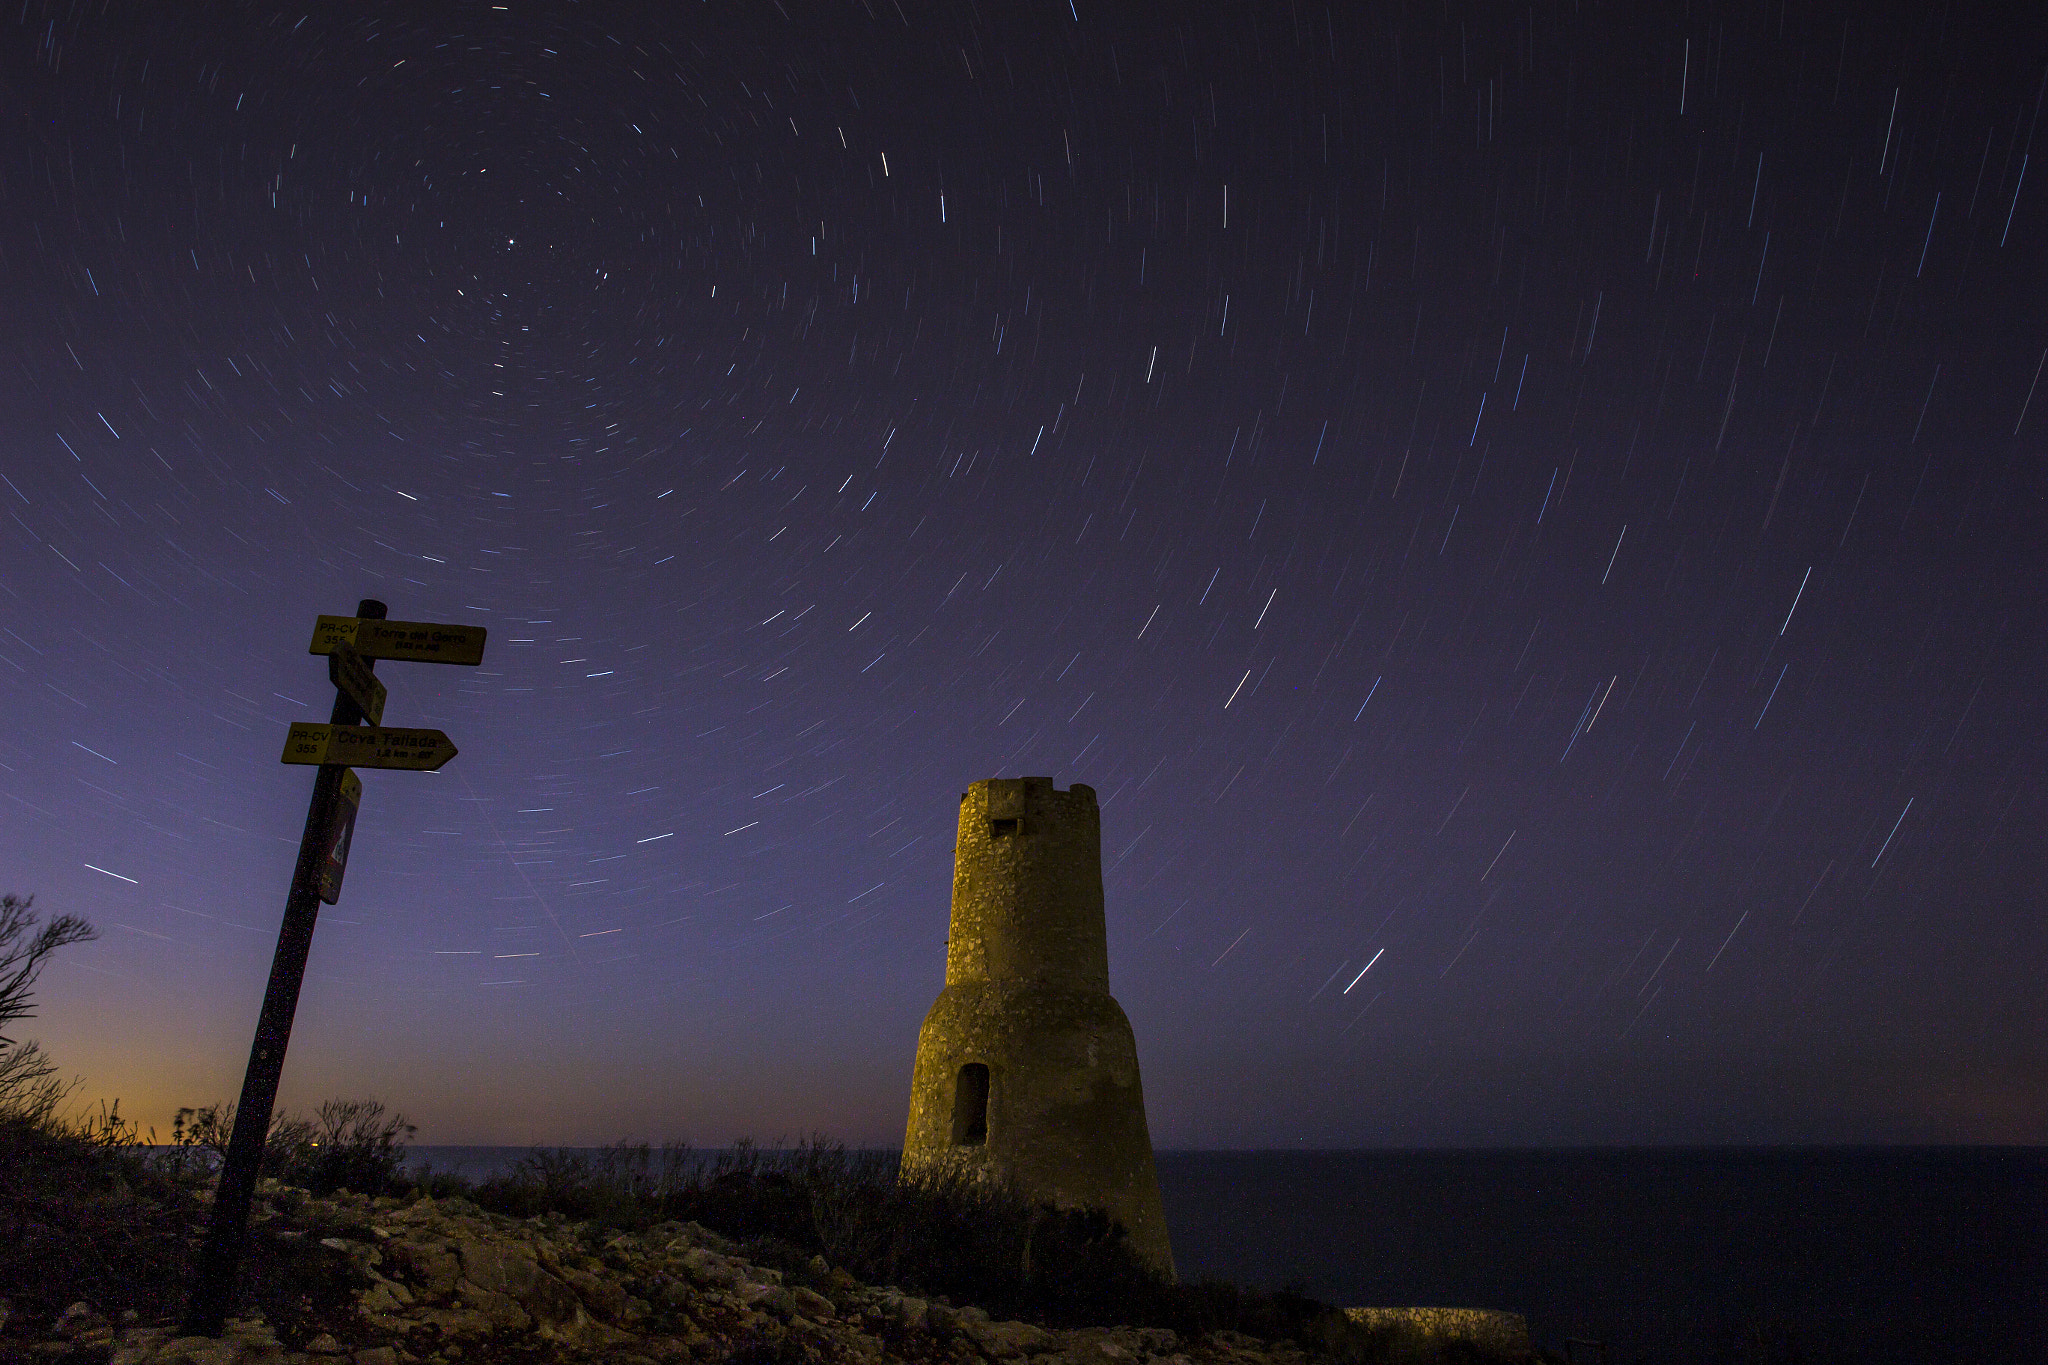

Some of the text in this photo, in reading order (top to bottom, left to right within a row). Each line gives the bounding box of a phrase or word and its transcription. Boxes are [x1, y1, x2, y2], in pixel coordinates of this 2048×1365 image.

[319, 622, 357, 634] PR-CV
[373, 627, 407, 639] Torre
[291, 731, 330, 742] PR-CV
[338, 731, 437, 748] Cova Tallada
[295, 743, 318, 754] 355
